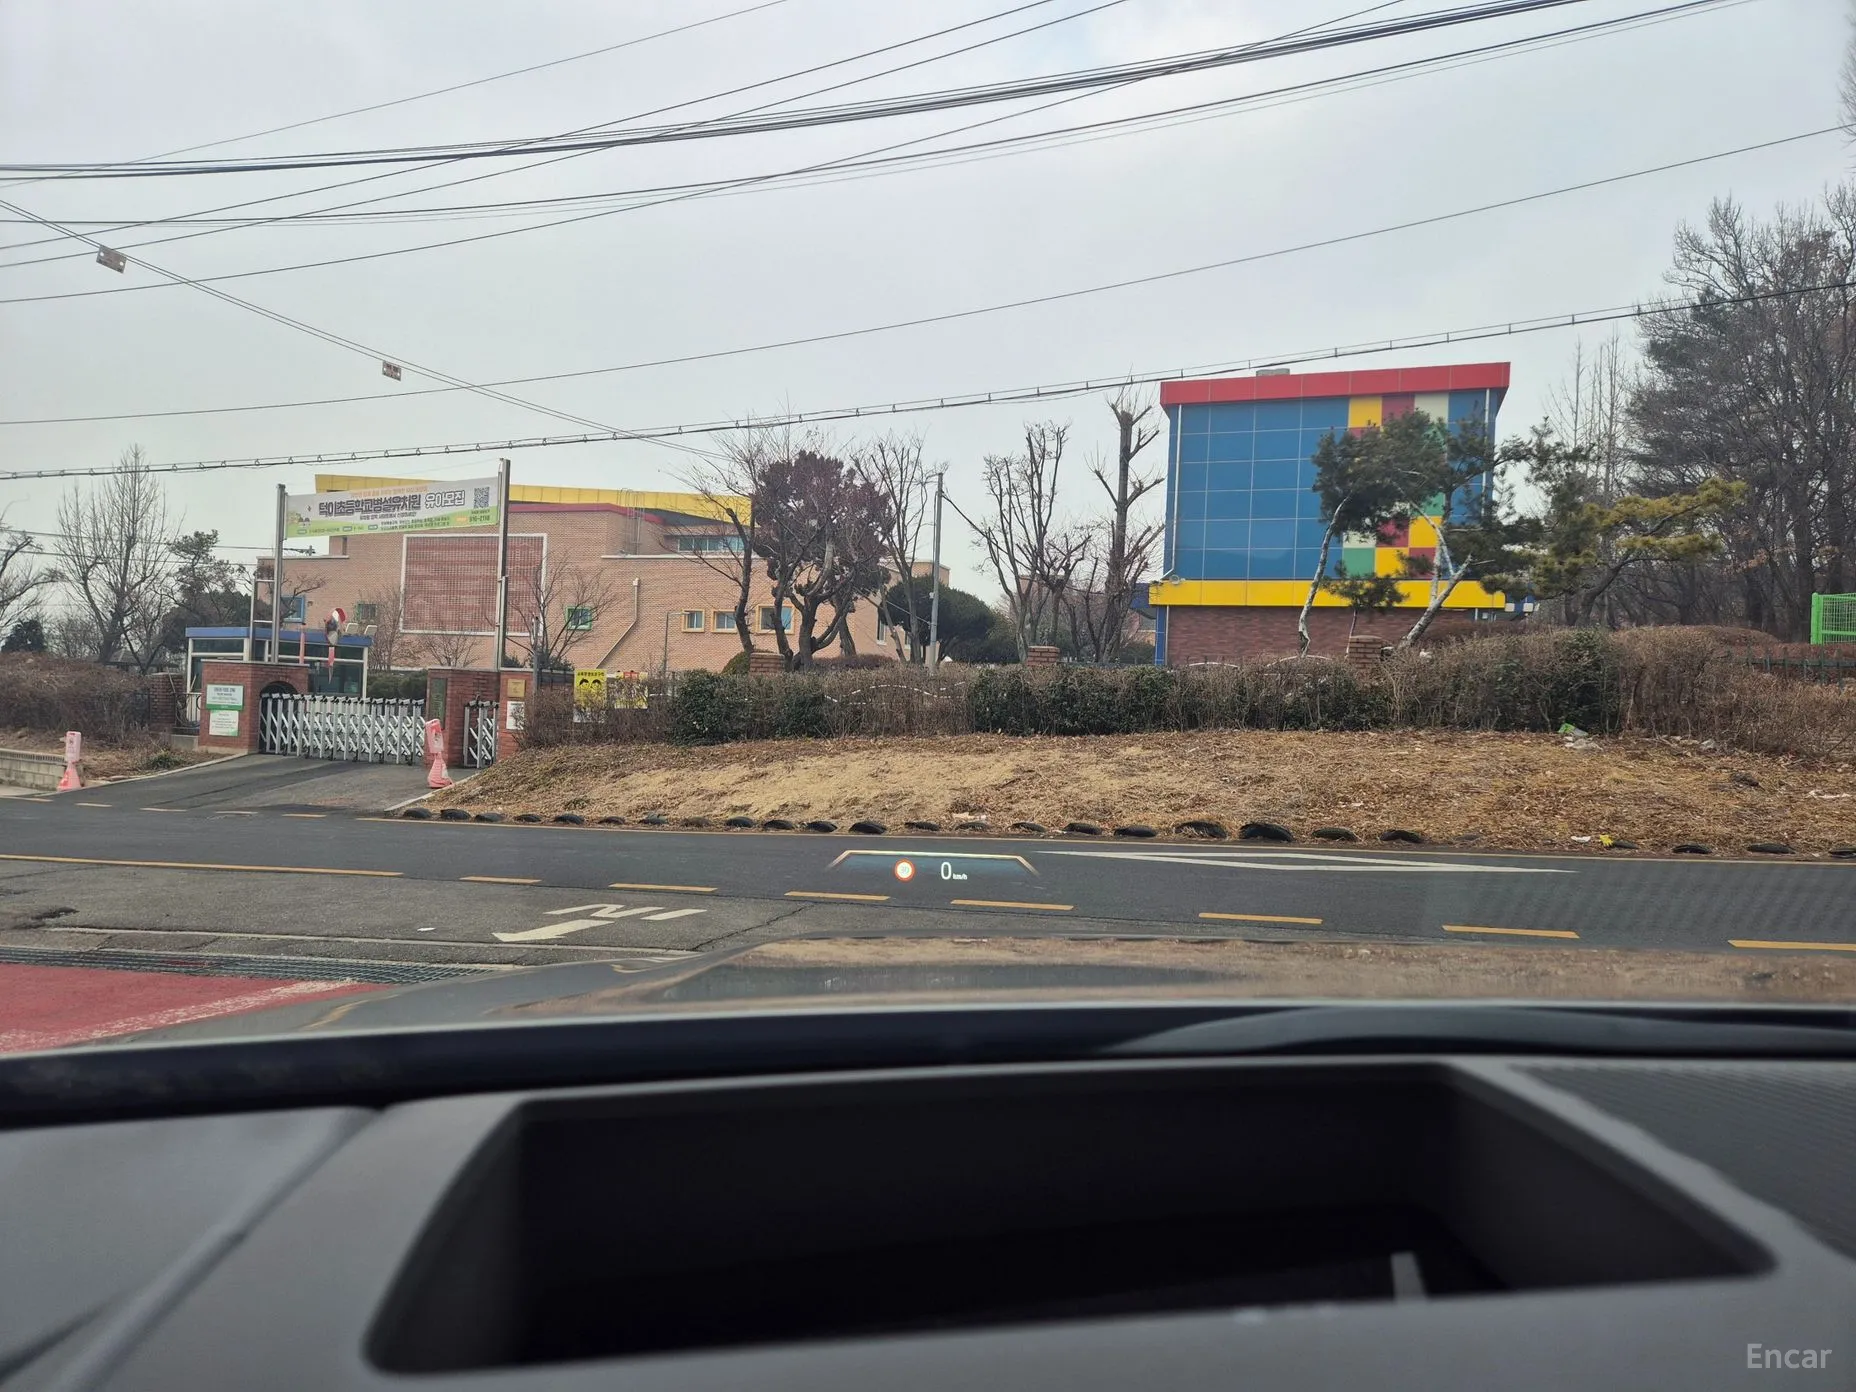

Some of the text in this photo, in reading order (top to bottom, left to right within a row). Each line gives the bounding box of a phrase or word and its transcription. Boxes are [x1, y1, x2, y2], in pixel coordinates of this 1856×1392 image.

[319, 494, 421, 517] 덕이초등학교병설유치원
[425, 490, 465, 509] 유아모집
[941, 861, 952, 880] 0
